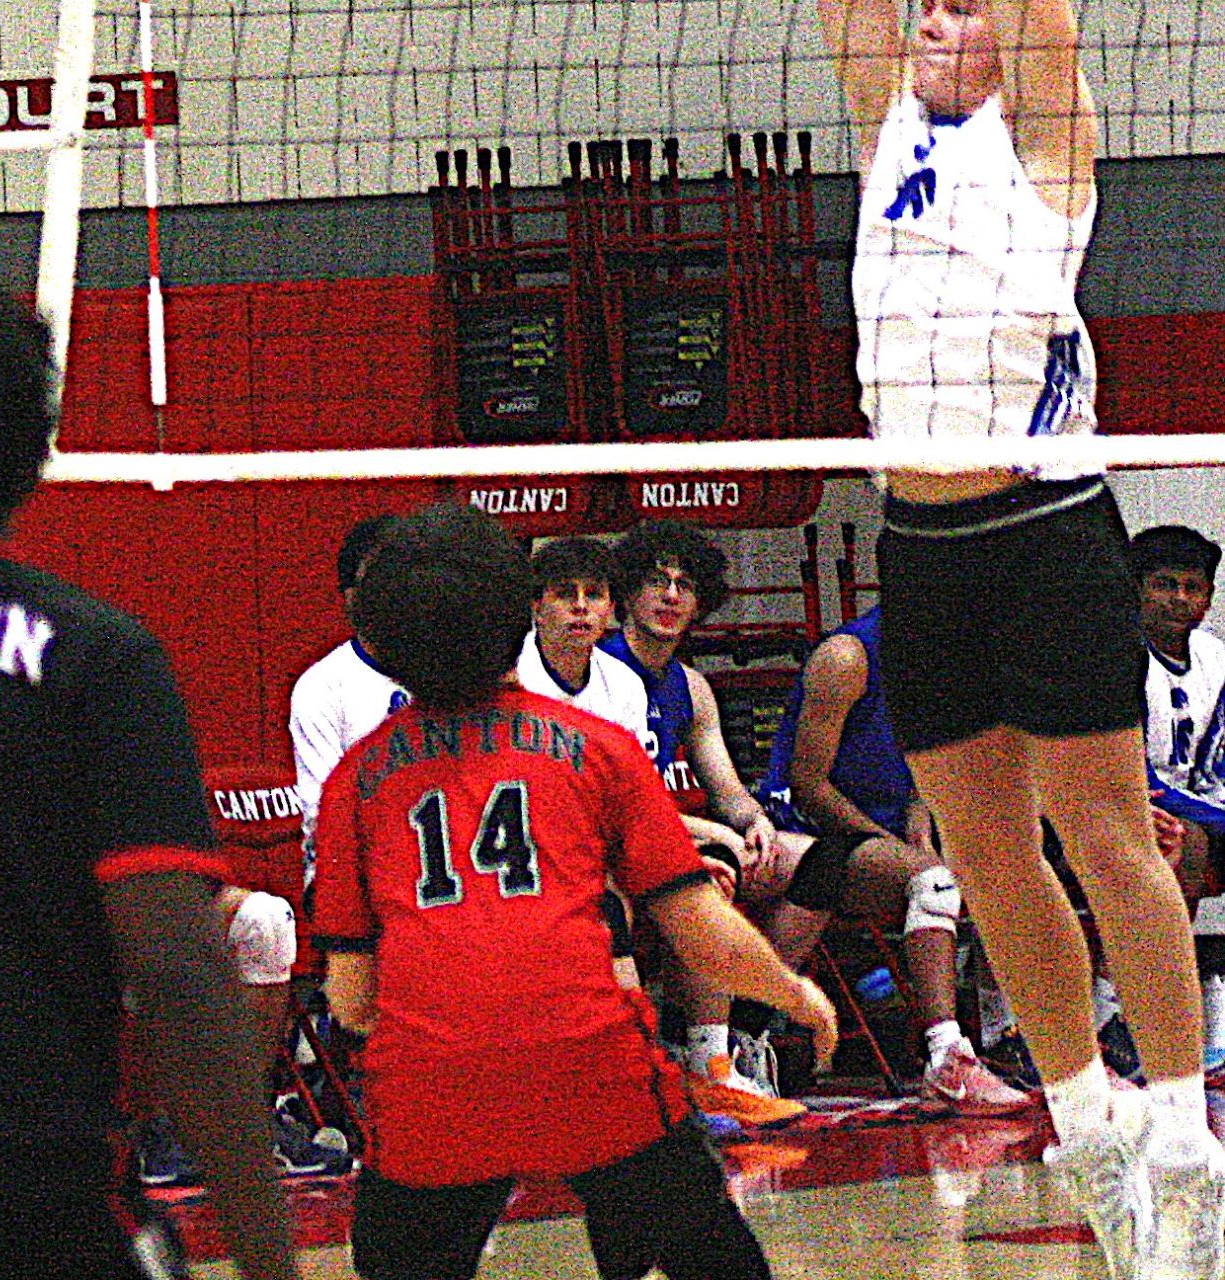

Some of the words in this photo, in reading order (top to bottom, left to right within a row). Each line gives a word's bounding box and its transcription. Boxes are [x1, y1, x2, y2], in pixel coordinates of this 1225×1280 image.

[470, 487, 568, 514] CANTON
[642, 482, 740, 507] CANTON
[214, 785, 302, 821] CANTON
[408, 780, 543, 909] 14
